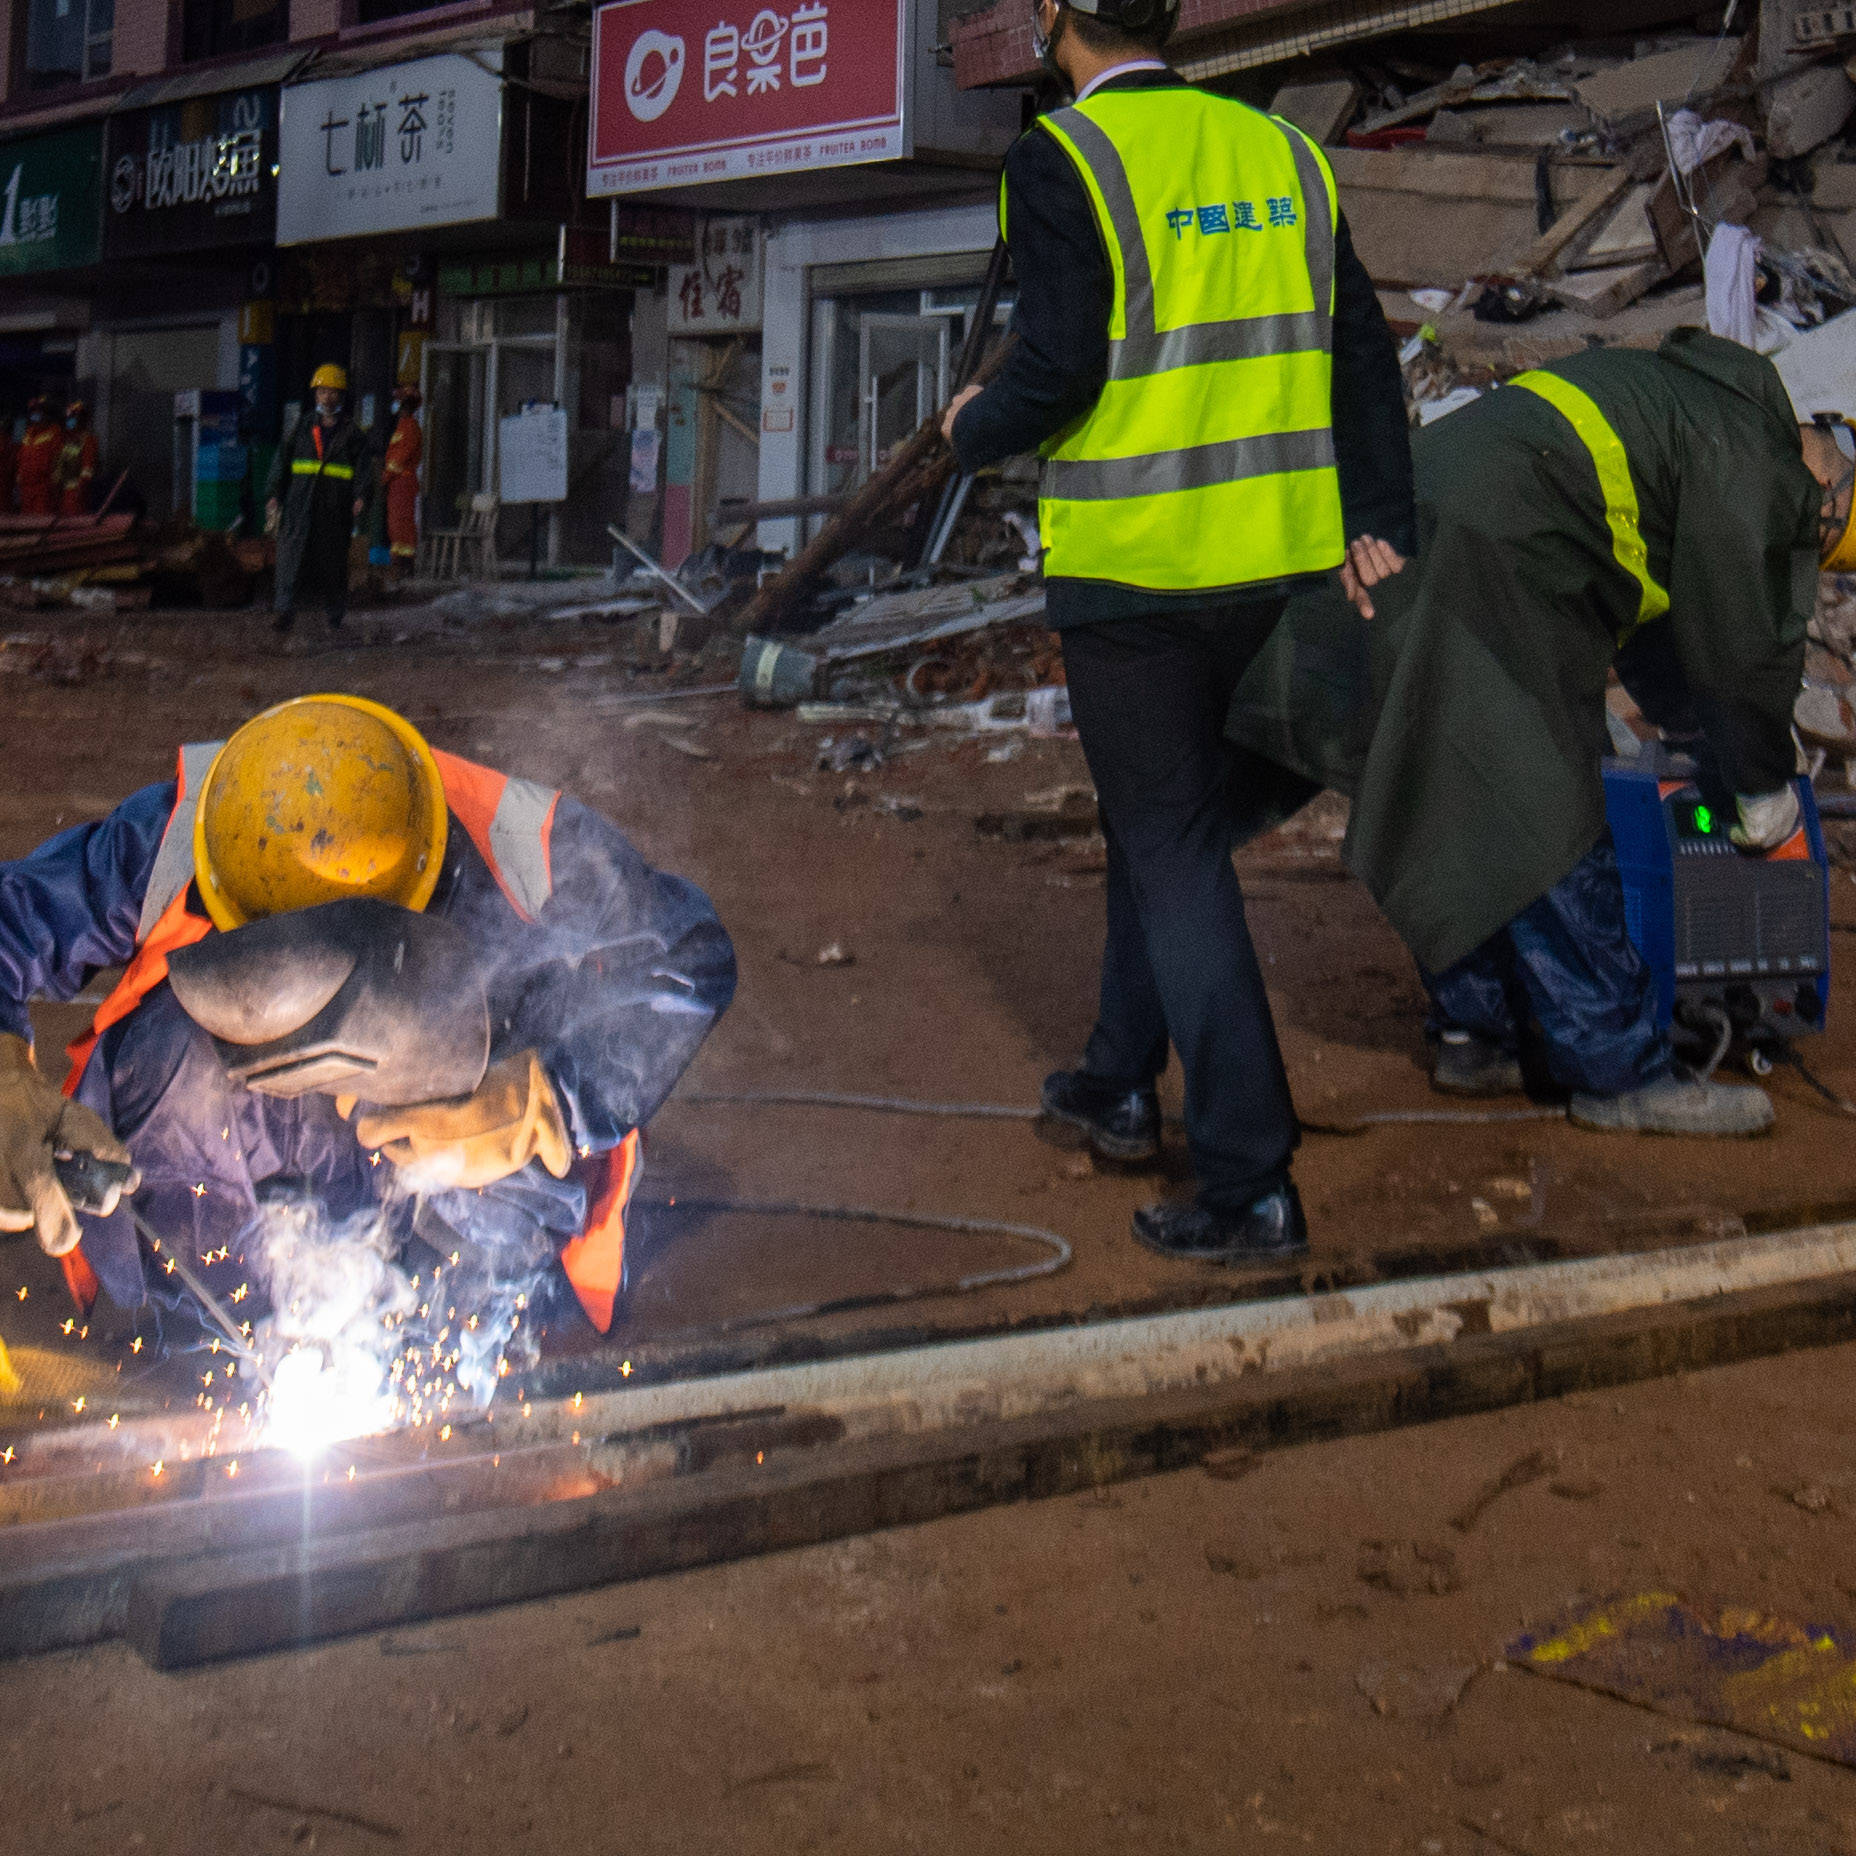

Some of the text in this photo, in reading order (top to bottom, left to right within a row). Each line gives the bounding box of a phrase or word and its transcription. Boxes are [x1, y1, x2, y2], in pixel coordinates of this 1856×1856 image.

[319, 90, 431, 176] 七杯茶
[1164, 196, 1298, 240] 中國建築
[678, 264, 745, 323] 住宿
